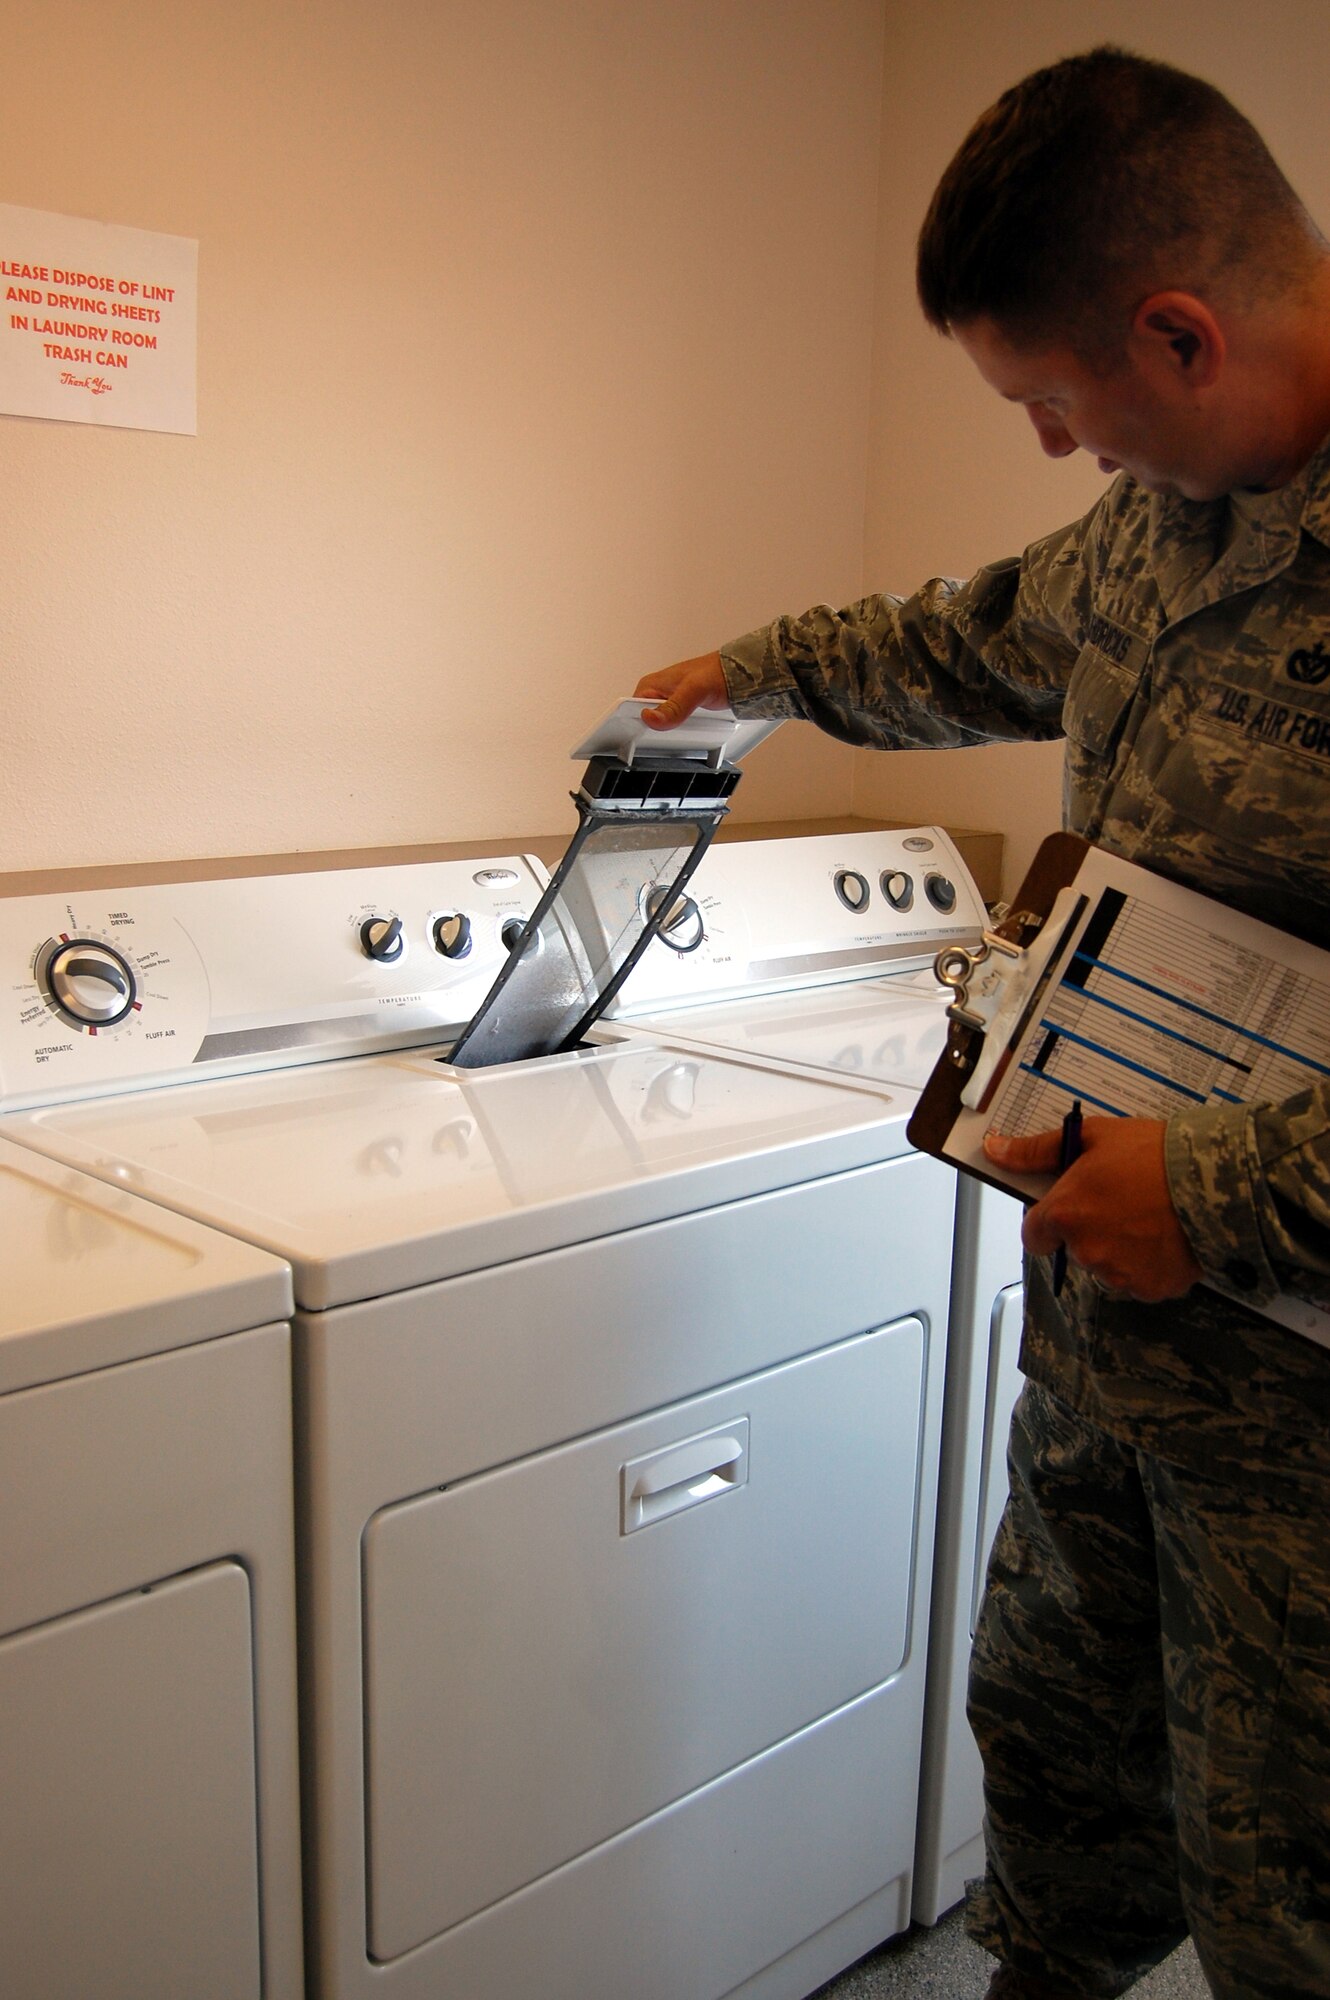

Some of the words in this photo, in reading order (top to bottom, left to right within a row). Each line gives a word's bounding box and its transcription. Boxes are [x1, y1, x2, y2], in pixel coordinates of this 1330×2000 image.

[53, 269, 115, 293] DISPOSE
[118, 281, 139, 297] OF
[142, 284, 176, 303] LINT
[6, 286, 43, 305] AND
[47, 292, 108, 316] DRYING
[111, 303, 161, 324] SHEETS
[10, 314, 29, 331] IN
[33, 318, 109, 343] LAUNDRY
[112, 330, 158, 349] ROOM
[43, 343, 92, 364] TRASH
[95, 351, 129, 369] CAN
[60, 371, 92, 389] Thank
[91, 377, 113, 395] You
[1247, 702, 1290, 740] AIR
[34, 1044, 73, 1055] AUTOMATIC
[145, 1031, 163, 1040] FLUFF
